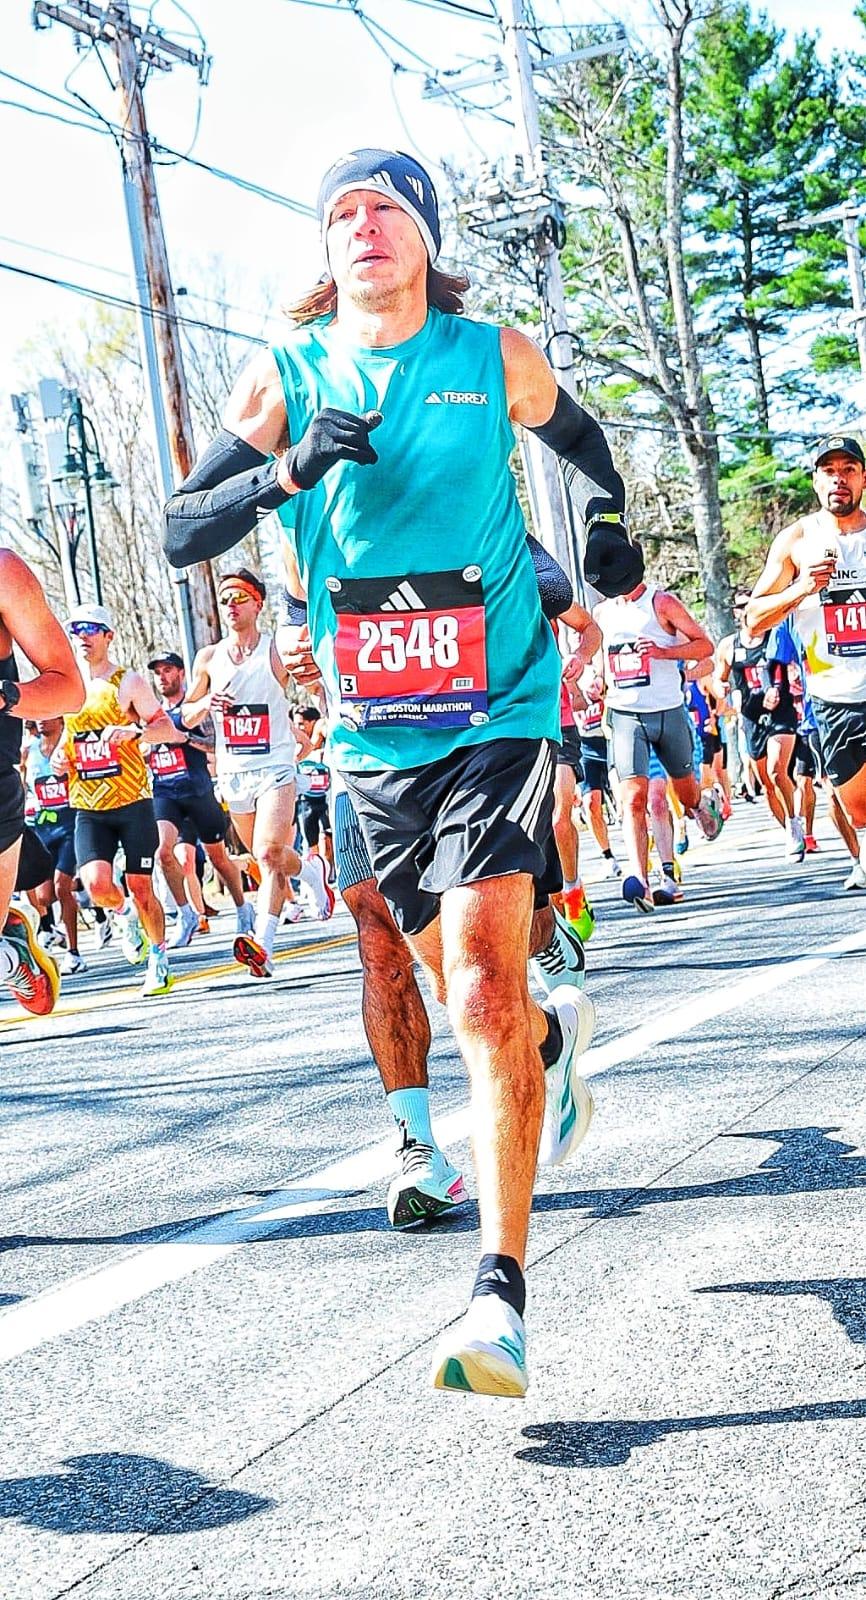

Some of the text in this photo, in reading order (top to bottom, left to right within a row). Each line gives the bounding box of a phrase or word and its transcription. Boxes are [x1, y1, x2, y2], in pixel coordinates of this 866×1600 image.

[442, 391, 489, 405] TERREX
[357, 616, 460, 672] 2548
[343, 678, 354, 692] 3
[387, 703, 420, 714] BOSTON
[422, 702, 472, 713] MARATHON
